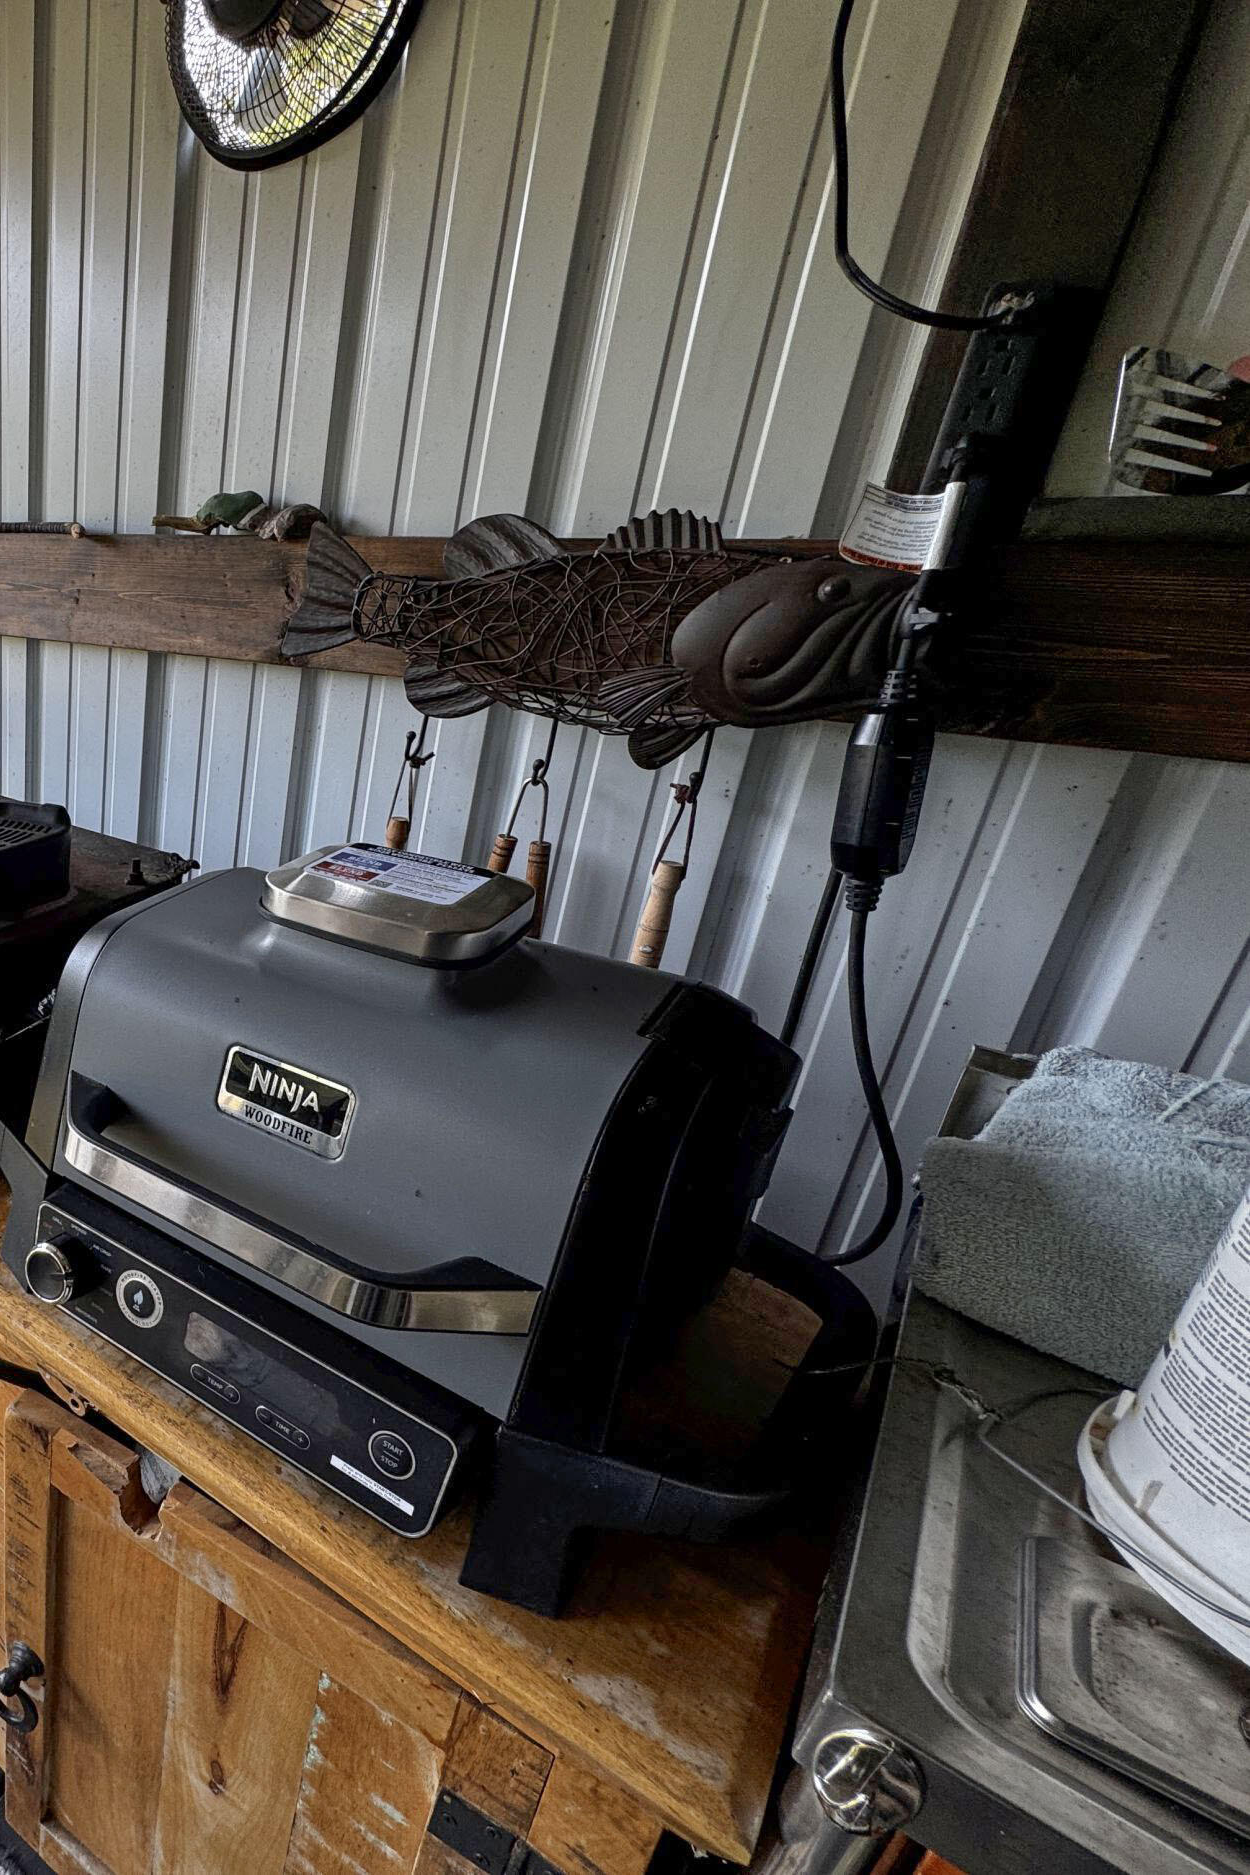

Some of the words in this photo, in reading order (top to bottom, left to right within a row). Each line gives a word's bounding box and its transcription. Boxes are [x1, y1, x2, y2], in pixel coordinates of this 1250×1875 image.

[248, 1062, 319, 1113] NINJA
[243, 1105, 313, 1145] WOODFIRE
[207, 1376, 223, 1390] TEMP
[275, 1421, 291, 1435] TIME
[382, 1440, 404, 1456] START
[380, 1455, 399, 1469] STOP
